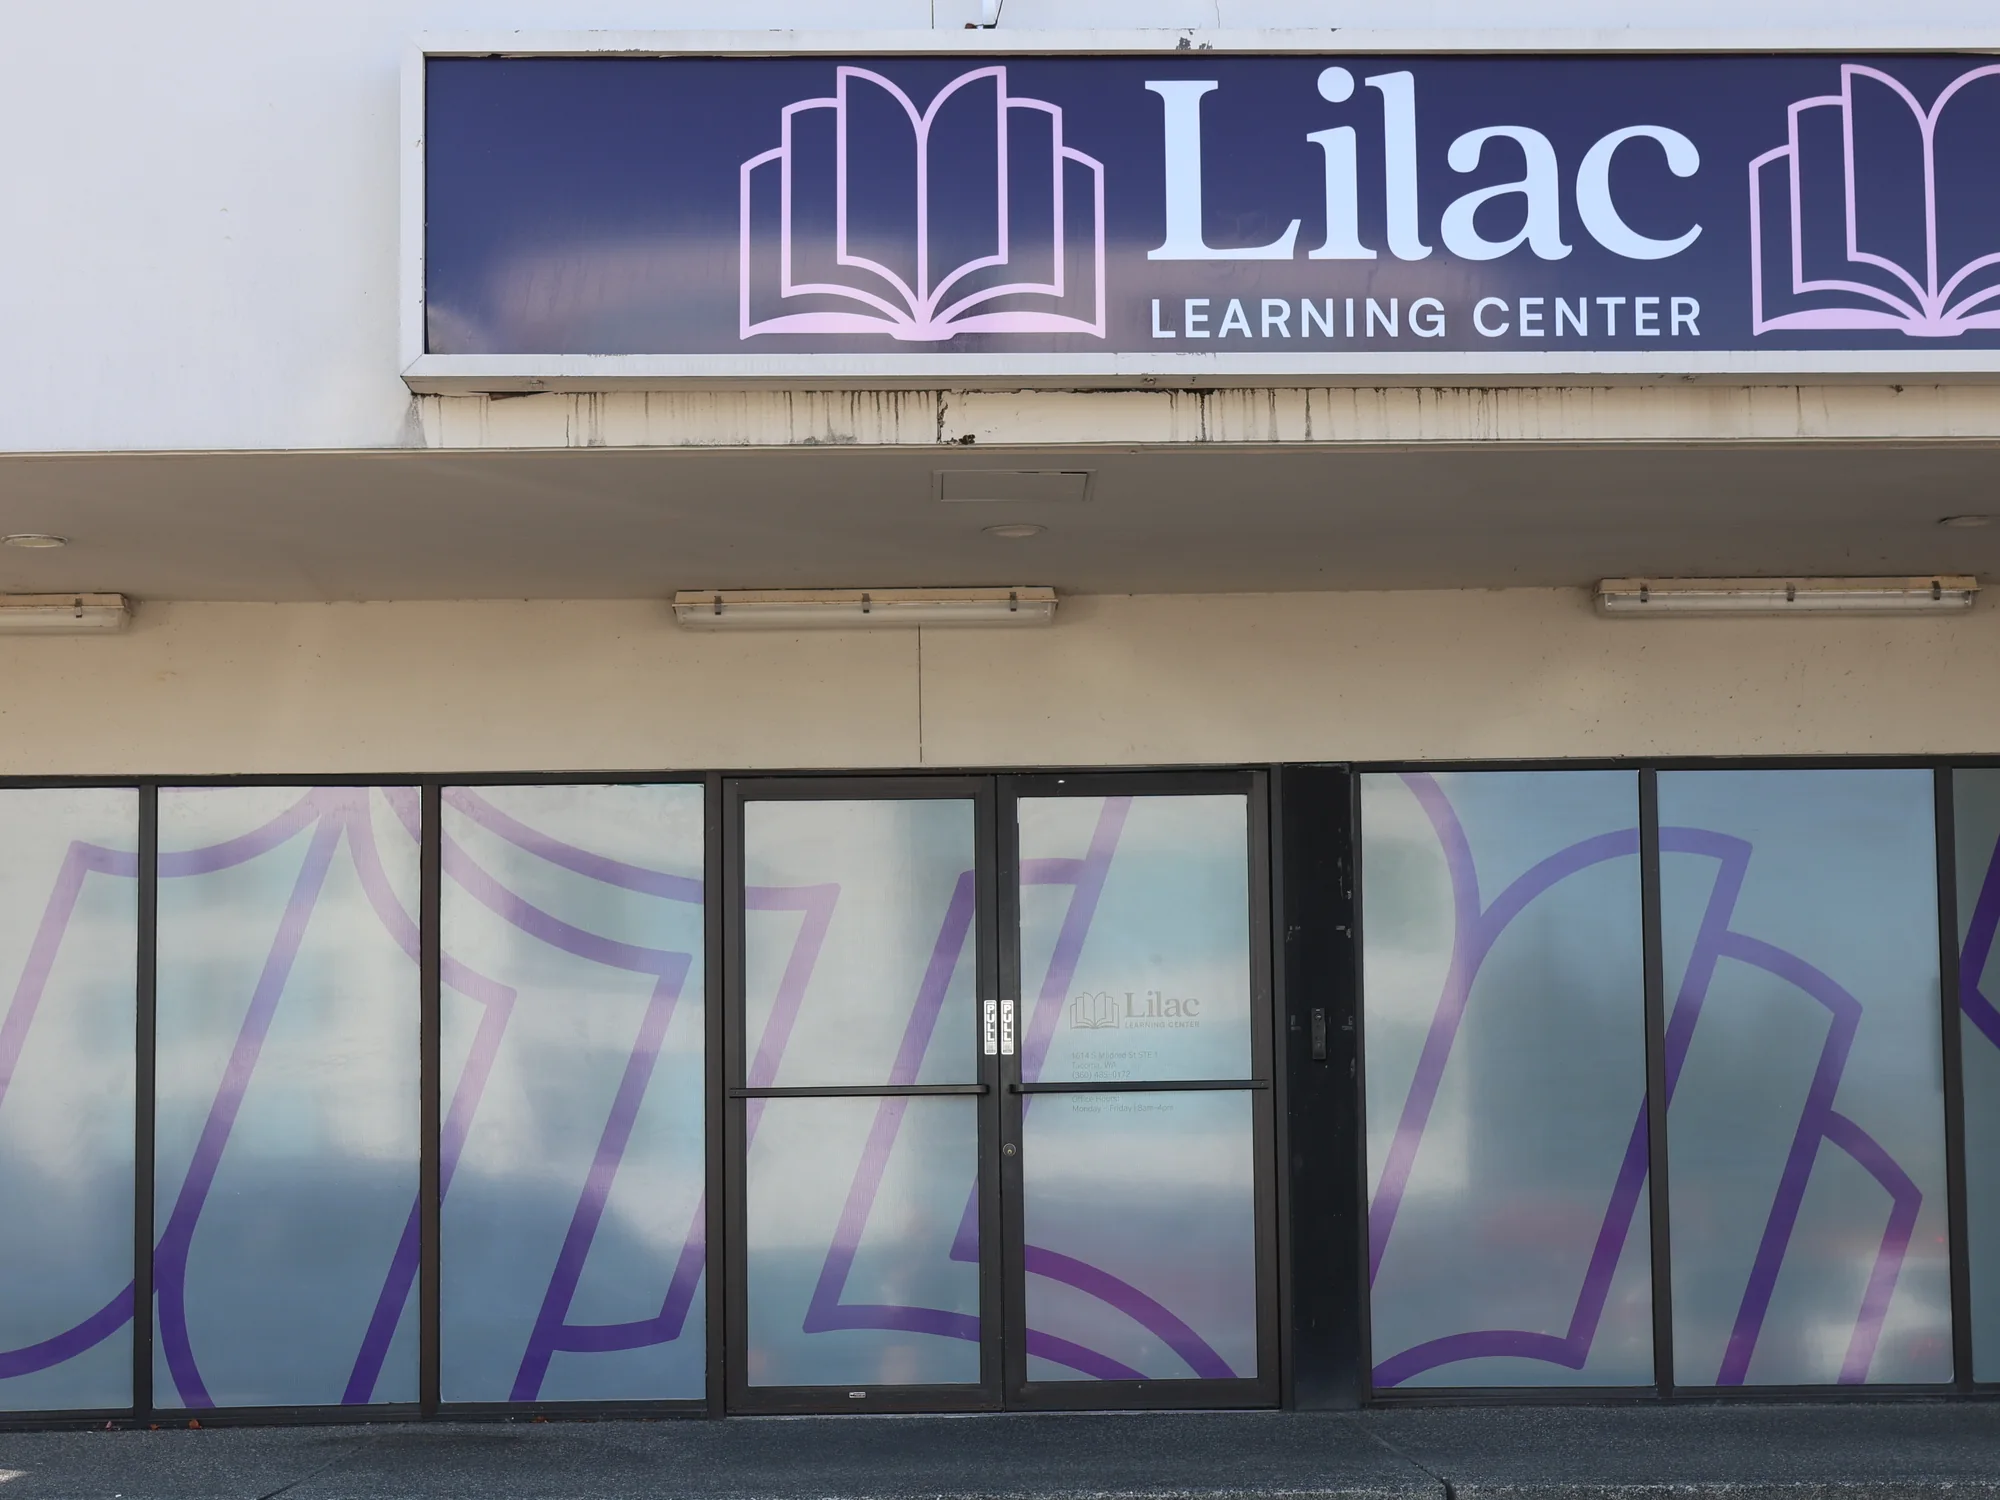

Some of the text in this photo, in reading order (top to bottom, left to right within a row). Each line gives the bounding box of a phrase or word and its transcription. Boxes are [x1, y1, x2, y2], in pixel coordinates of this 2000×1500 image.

[1145, 66, 1702, 261] Lilac
[1152, 296, 1701, 339] LEARNING CENTER
[986, 1004, 995, 1041] PULL
[1003, 1004, 1012, 1041] PULL
[1124, 990, 1200, 1018] Lilac
[1125, 1020, 1200, 1029] LEARNING CENTER
[1072, 1105, 1101, 1114] Monday
[1109, 1104, 1132, 1113] Friday
